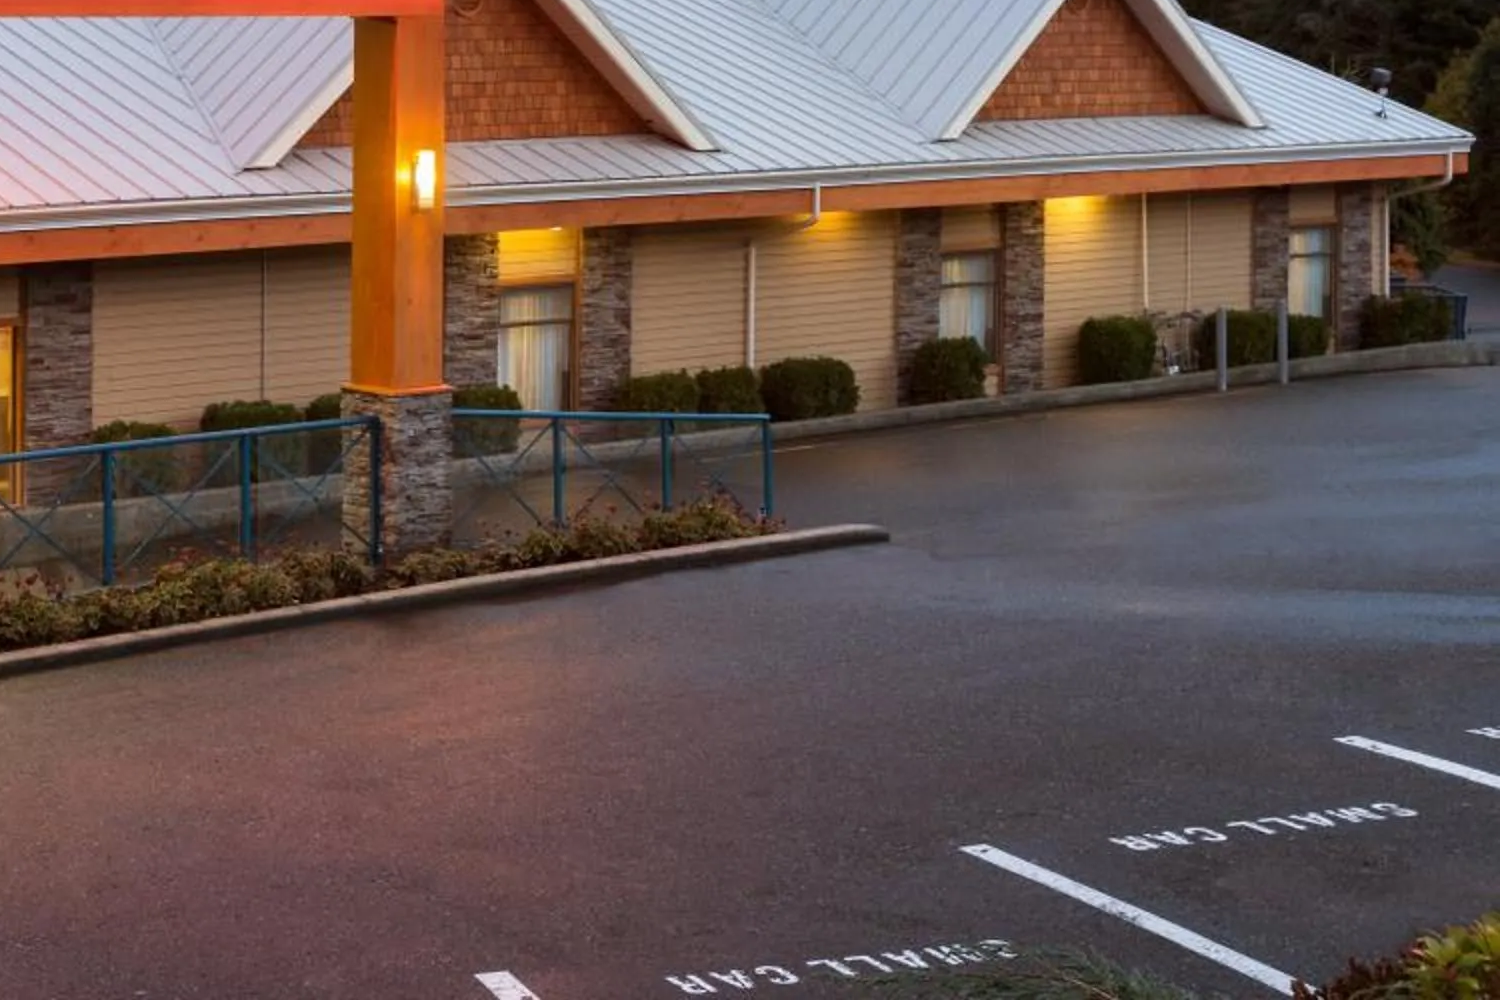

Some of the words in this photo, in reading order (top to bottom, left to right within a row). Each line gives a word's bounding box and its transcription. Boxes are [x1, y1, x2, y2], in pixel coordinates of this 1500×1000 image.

[1225, 803, 1418, 835] SMALL
[1108, 827, 1228, 851] CAR
[664, 965, 800, 995] CAR
